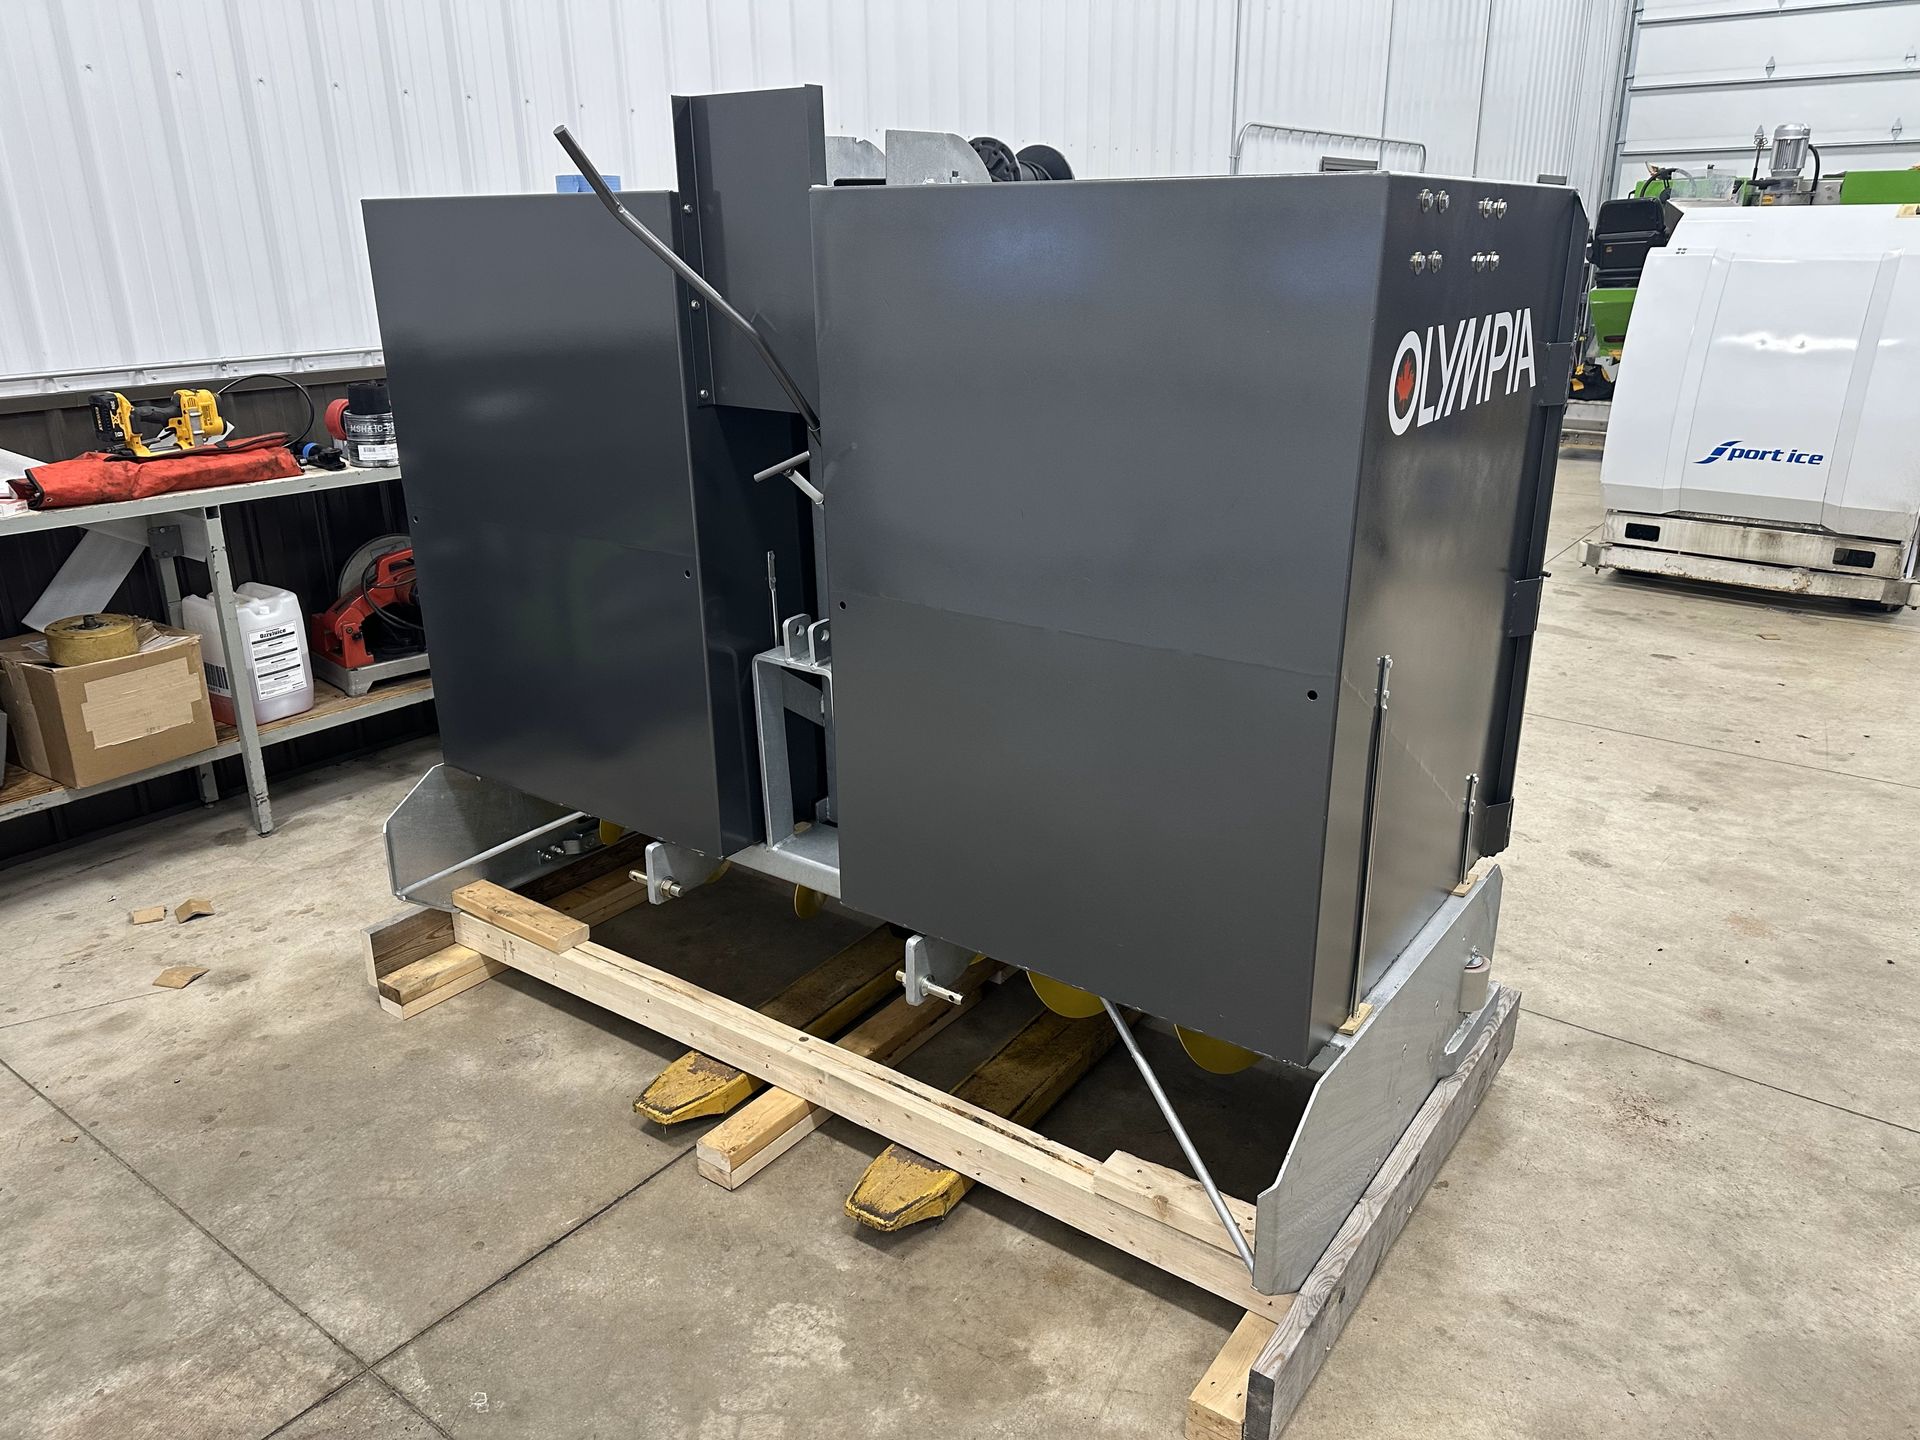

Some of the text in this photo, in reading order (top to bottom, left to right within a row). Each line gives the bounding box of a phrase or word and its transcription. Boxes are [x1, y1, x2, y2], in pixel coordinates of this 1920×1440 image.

[1388, 307, 1537, 436] OLYMPIA
[1692, 440, 1824, 465] Sport ice
